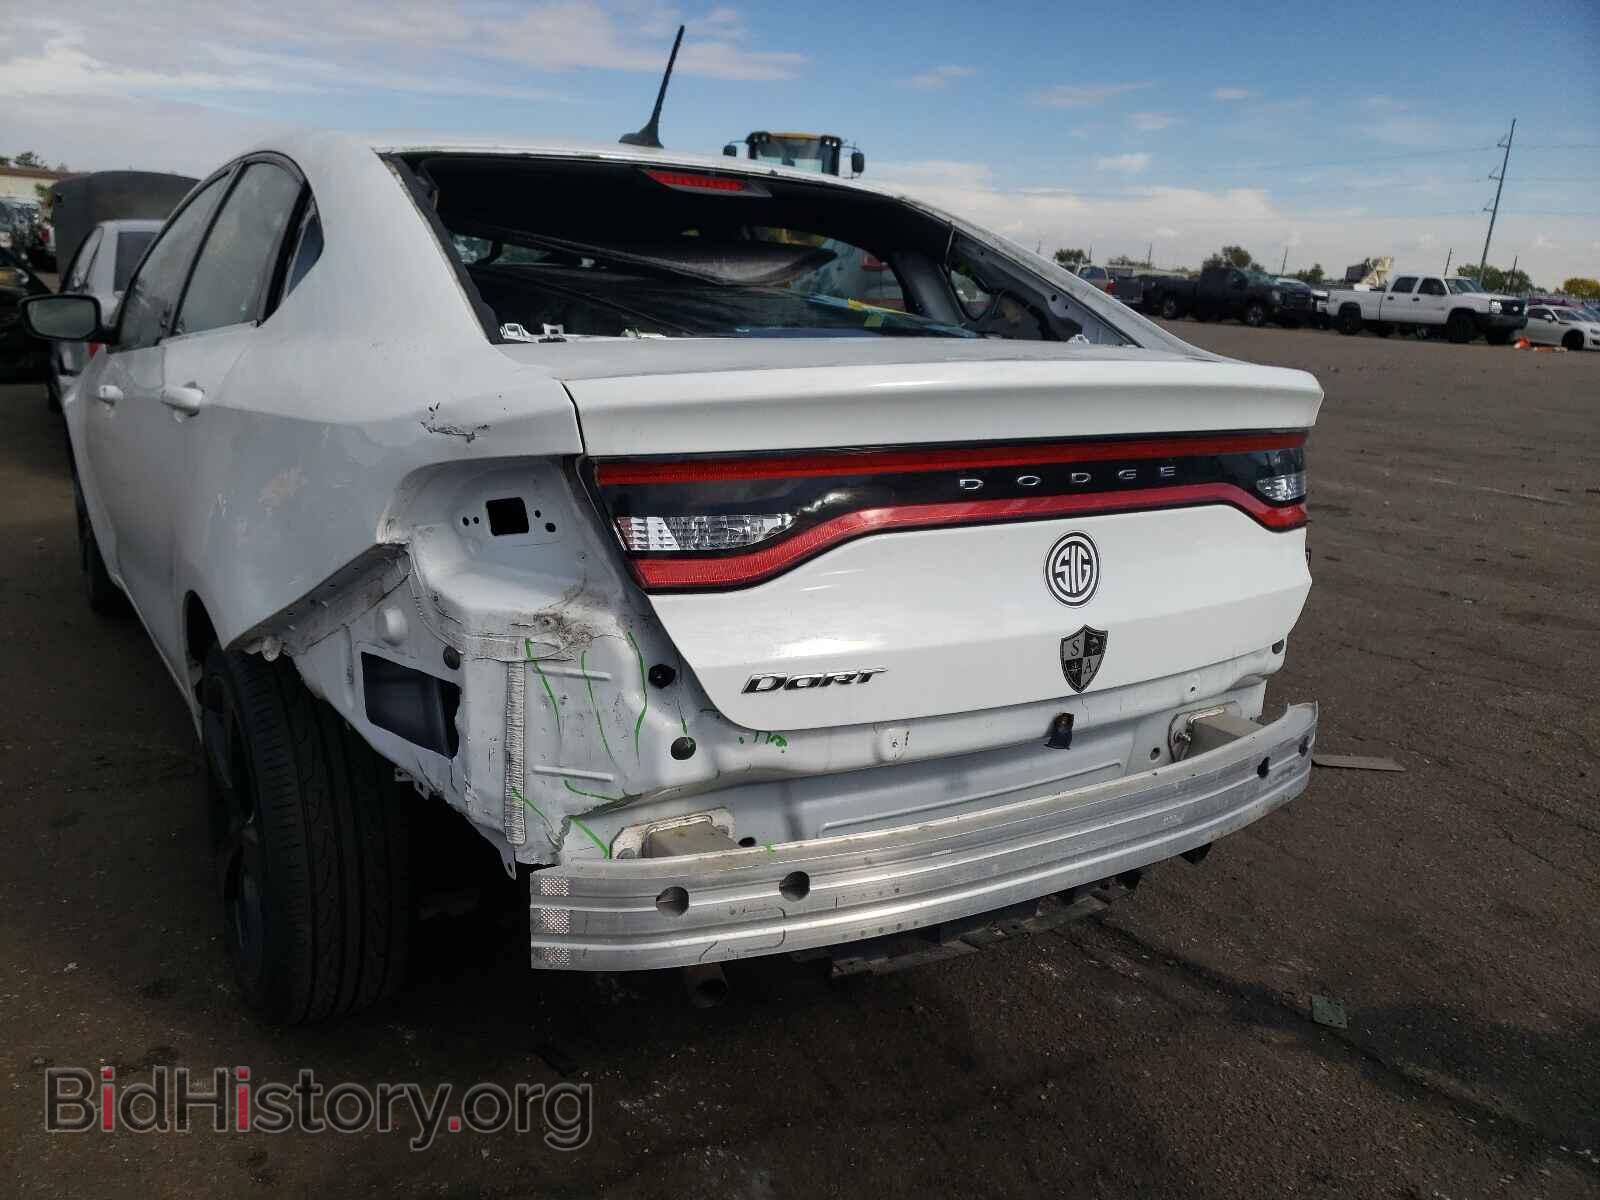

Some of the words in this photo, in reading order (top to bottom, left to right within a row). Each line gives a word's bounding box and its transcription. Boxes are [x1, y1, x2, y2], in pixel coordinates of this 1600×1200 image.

[959, 466, 1177, 490] DODGE
[1055, 544, 1092, 594] SIG
[1070, 639, 1080, 657] S
[1083, 658, 1094, 674] A
